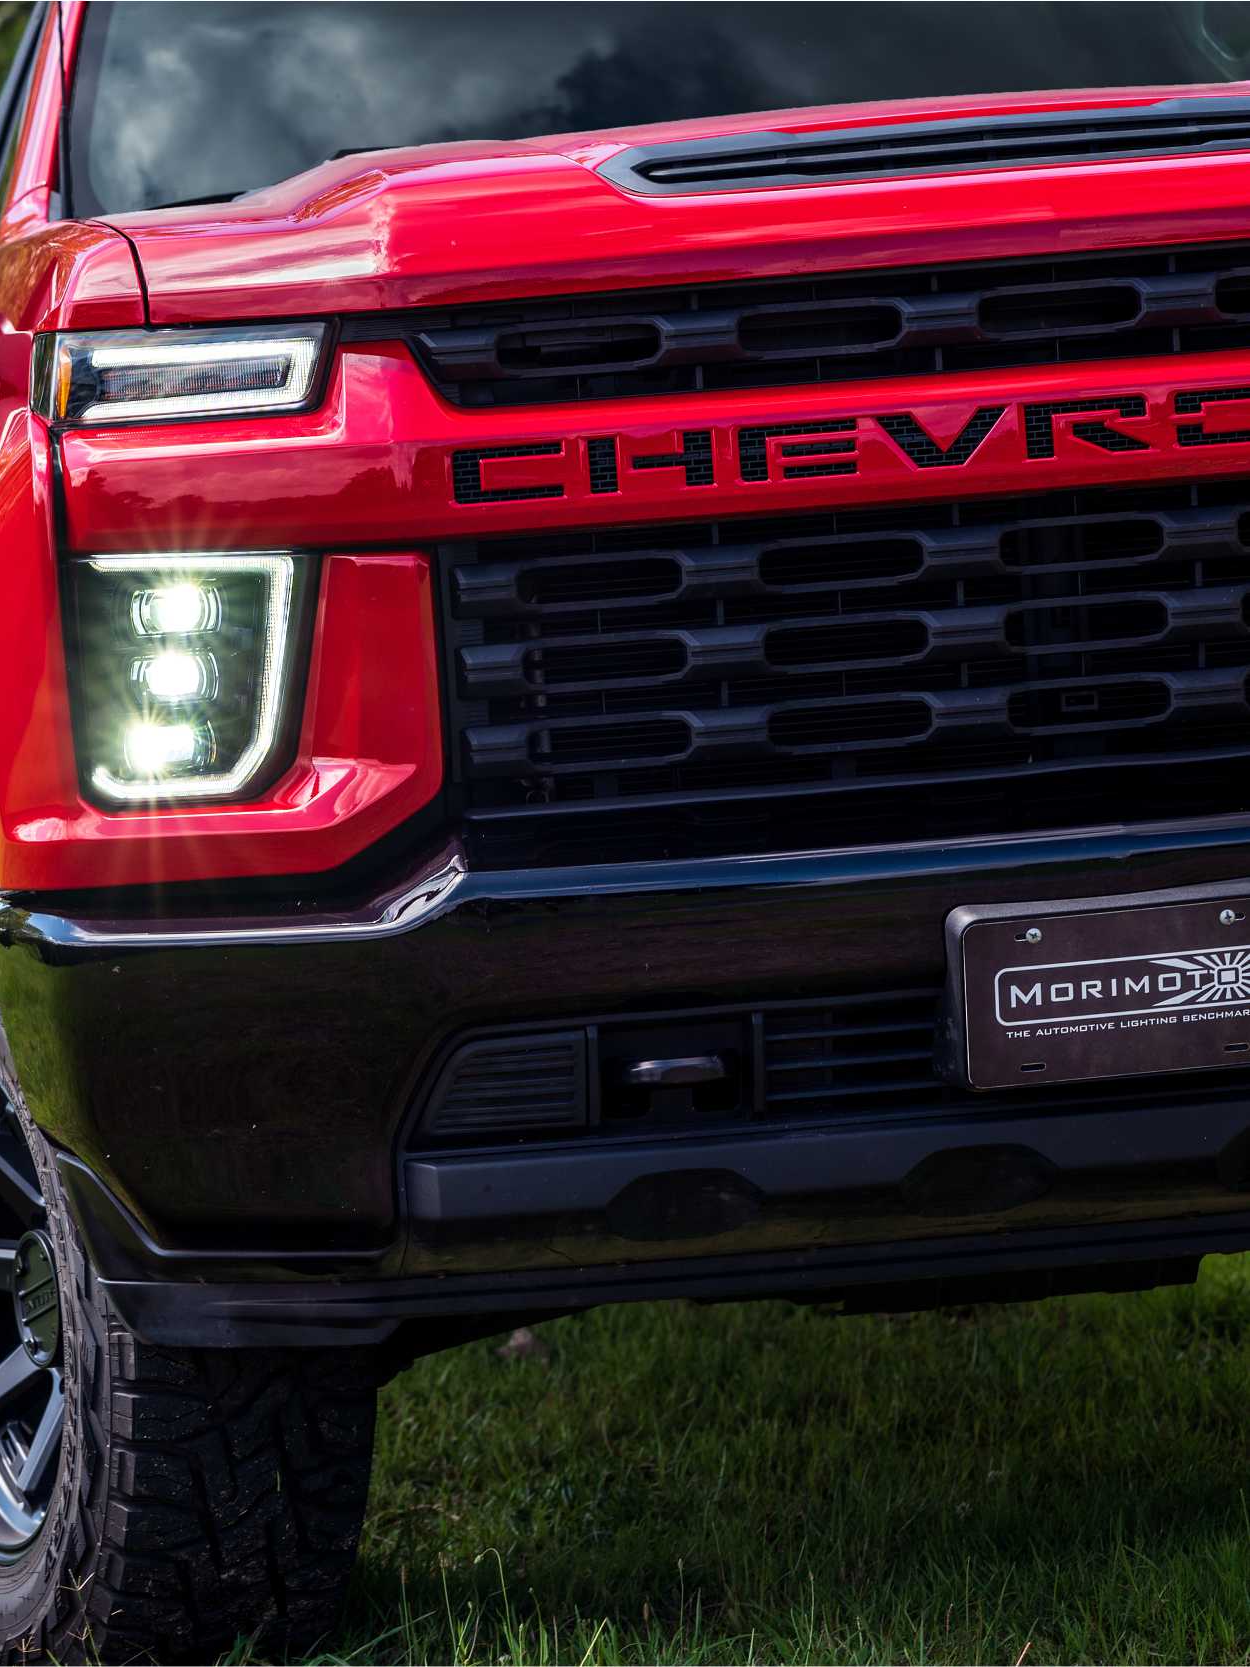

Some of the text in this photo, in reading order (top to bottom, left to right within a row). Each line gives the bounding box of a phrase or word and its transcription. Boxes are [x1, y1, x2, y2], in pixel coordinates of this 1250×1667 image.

[1006, 1030, 1031, 1039] THE
[1036, 1022, 1115, 1037] AUTOMOTIVE
[1120, 1016, 1177, 1029] LIGHTING
